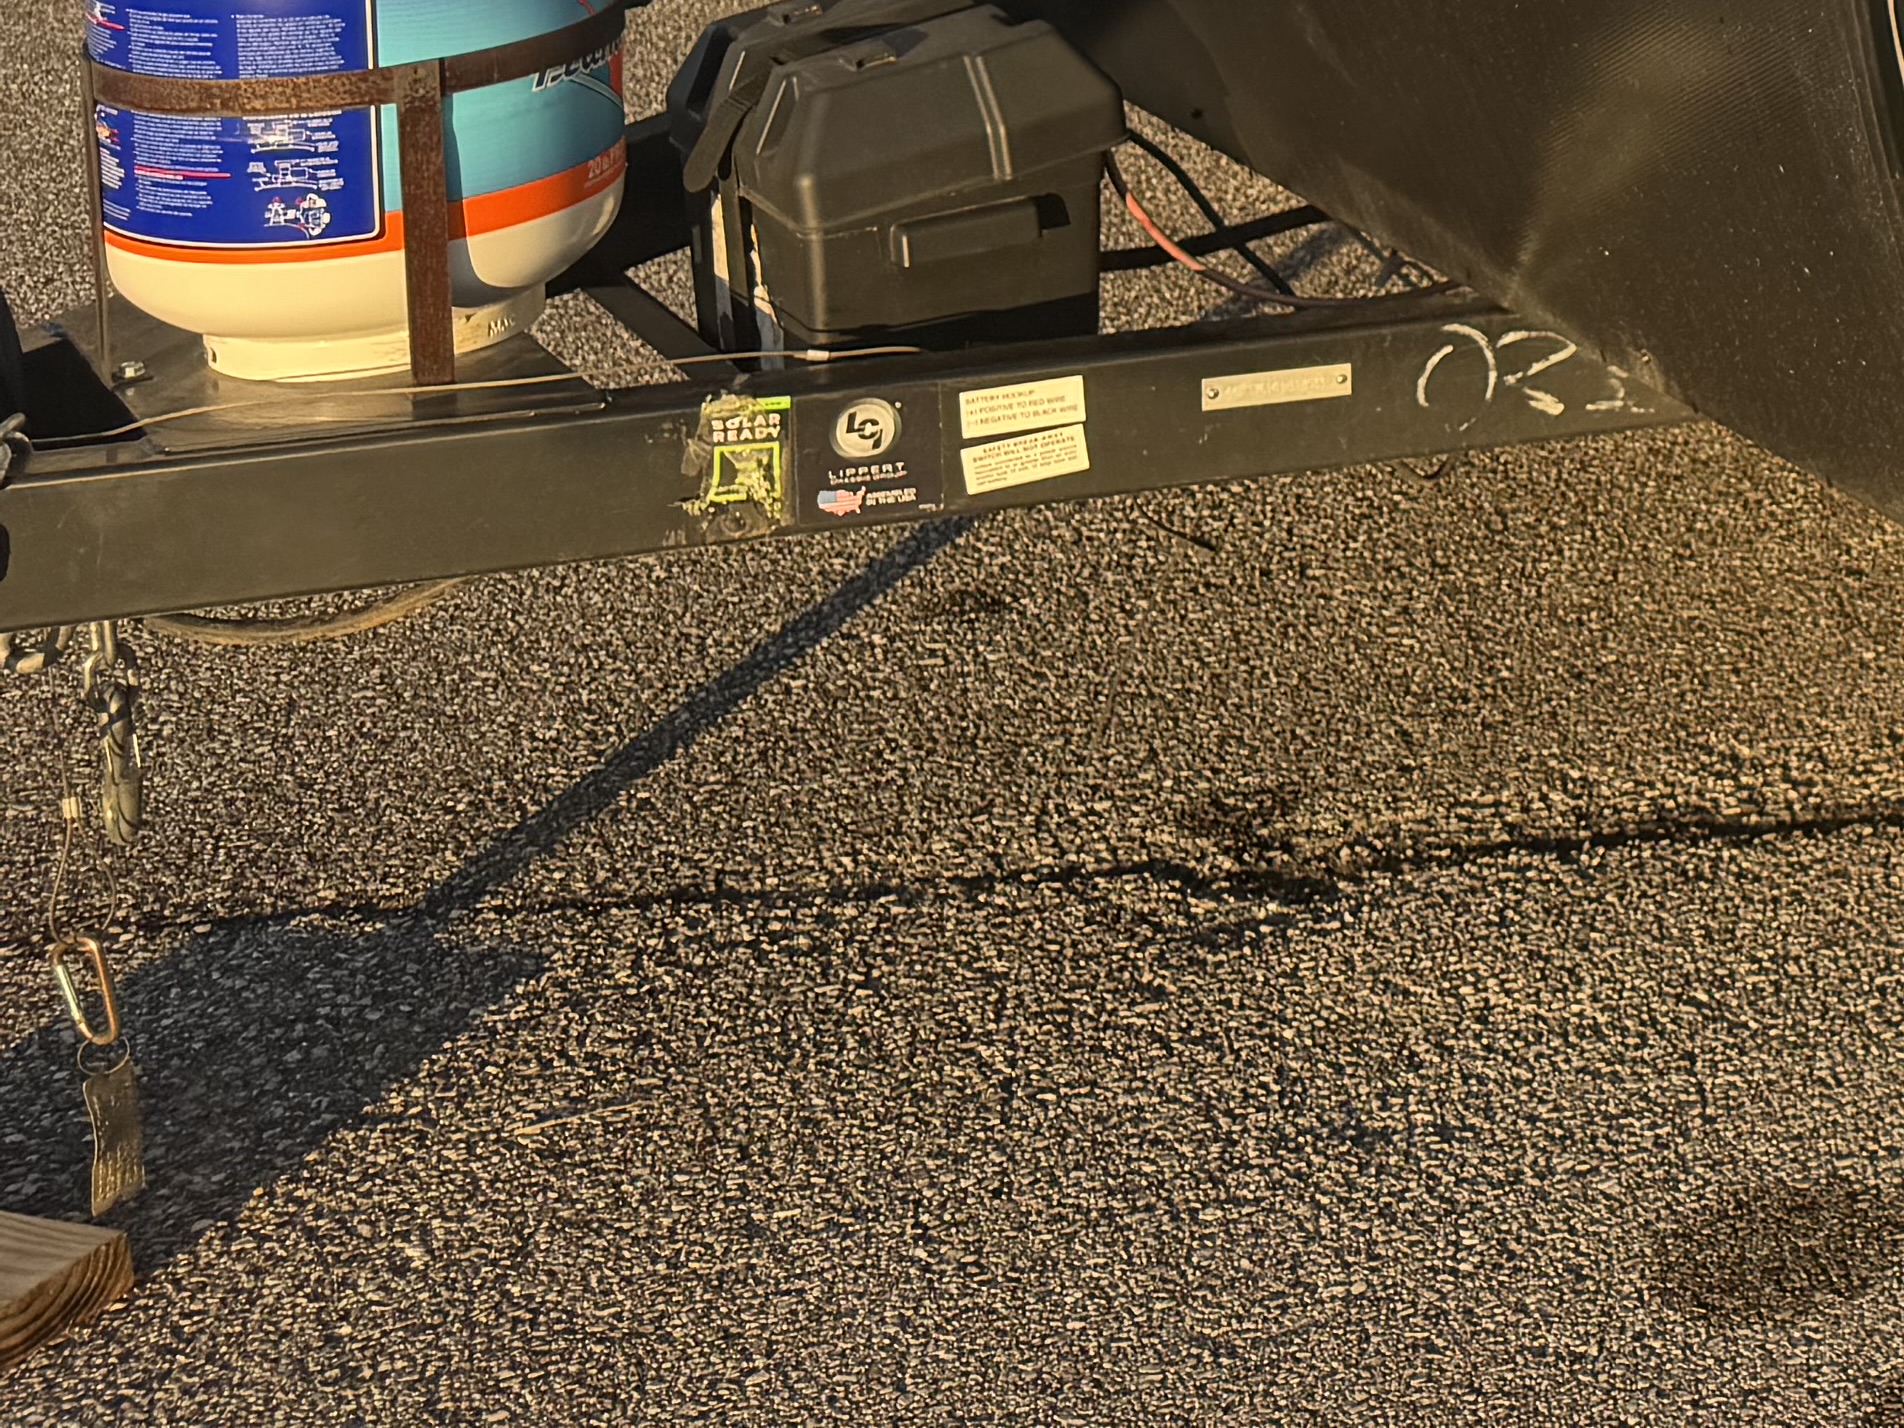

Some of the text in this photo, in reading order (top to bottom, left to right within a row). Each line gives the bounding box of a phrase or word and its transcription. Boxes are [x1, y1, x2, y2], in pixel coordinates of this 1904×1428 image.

[965, 393, 1000, 405] BATTERY
[979, 403, 1014, 415] POSITIVE
[1016, 401, 1027, 410] TO
[1028, 398, 1045, 408] RED
[1047, 395, 1066, 405] WIRE
[711, 412, 782, 431] SOLAR
[980, 413, 1018, 425] NEGATIVE
[1020, 411, 1031, 419] TO
[1032, 407, 1057, 418] BLACK
[1059, 403, 1078, 414] WIRE
[712, 424, 781, 443] READY
[828, 461, 906, 480] LIPPERT
